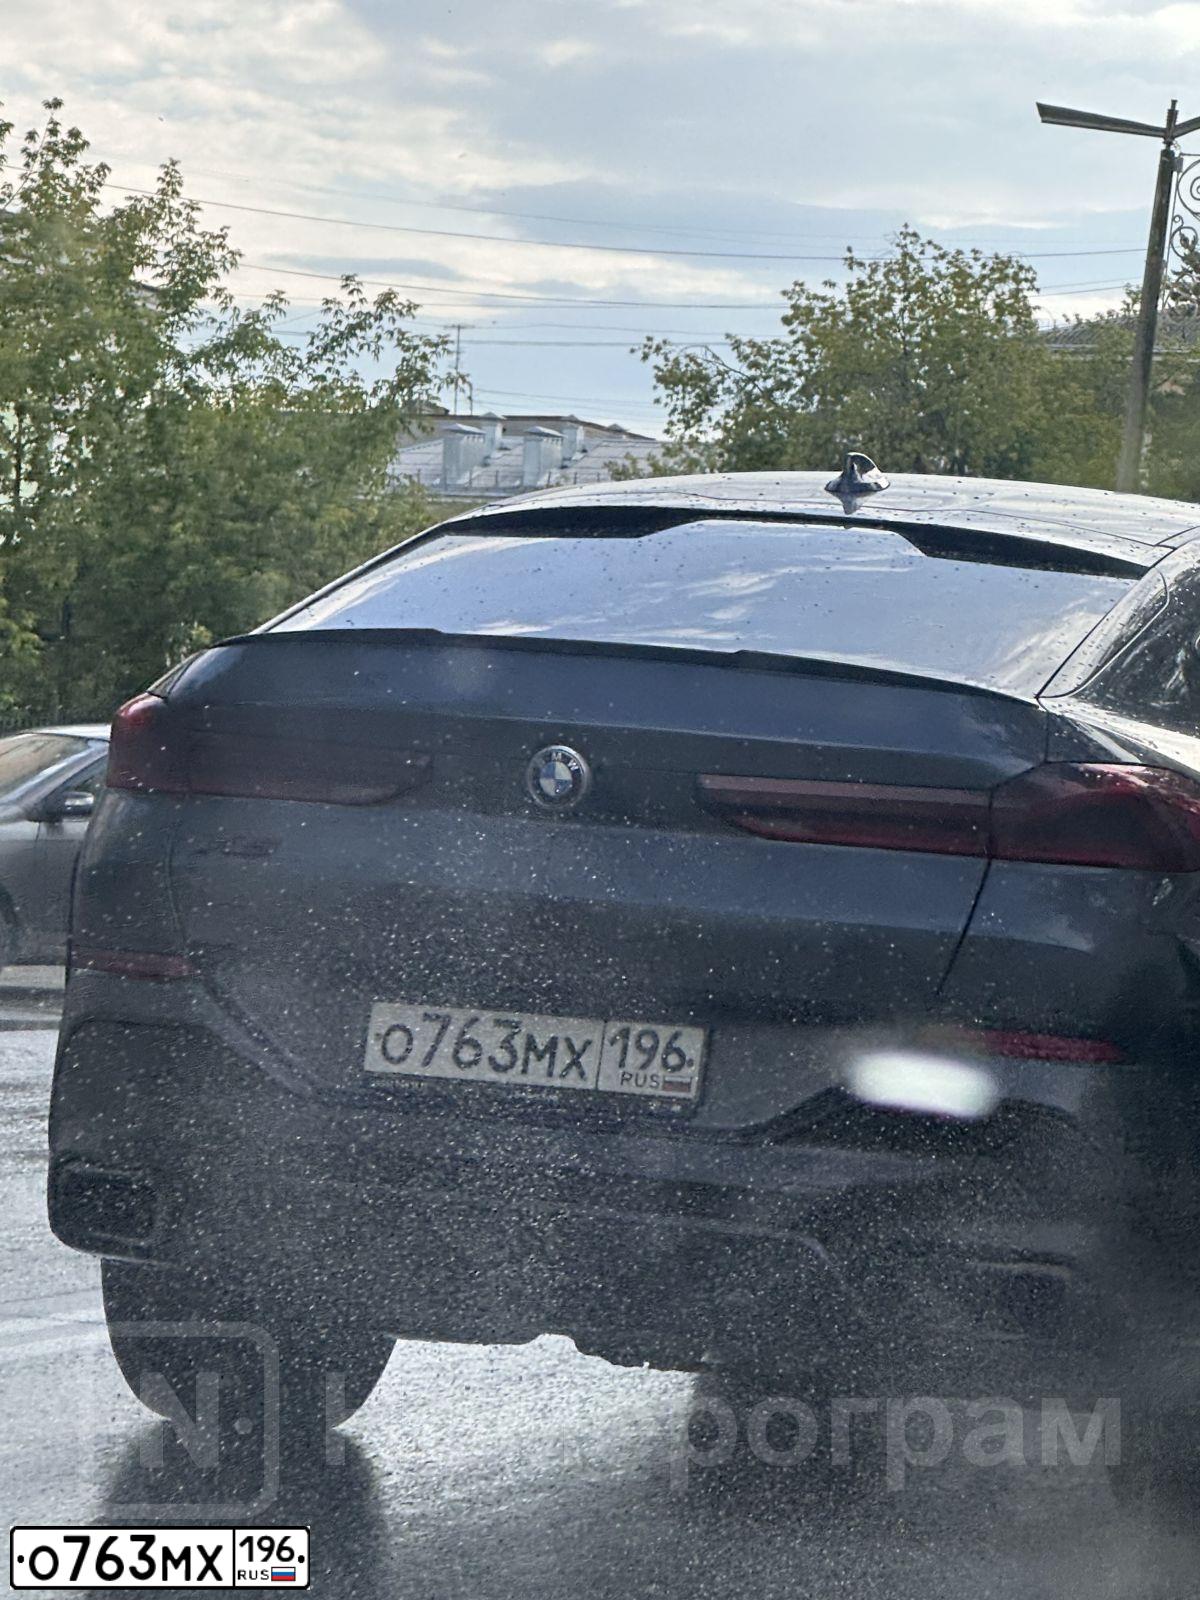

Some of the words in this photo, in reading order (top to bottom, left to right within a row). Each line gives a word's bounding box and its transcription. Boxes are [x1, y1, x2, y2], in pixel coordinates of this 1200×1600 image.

[380, 1011, 593, 1080] O763MX
[608, 1026, 687, 1074] 196
[620, 1072, 660, 1090] RUS
